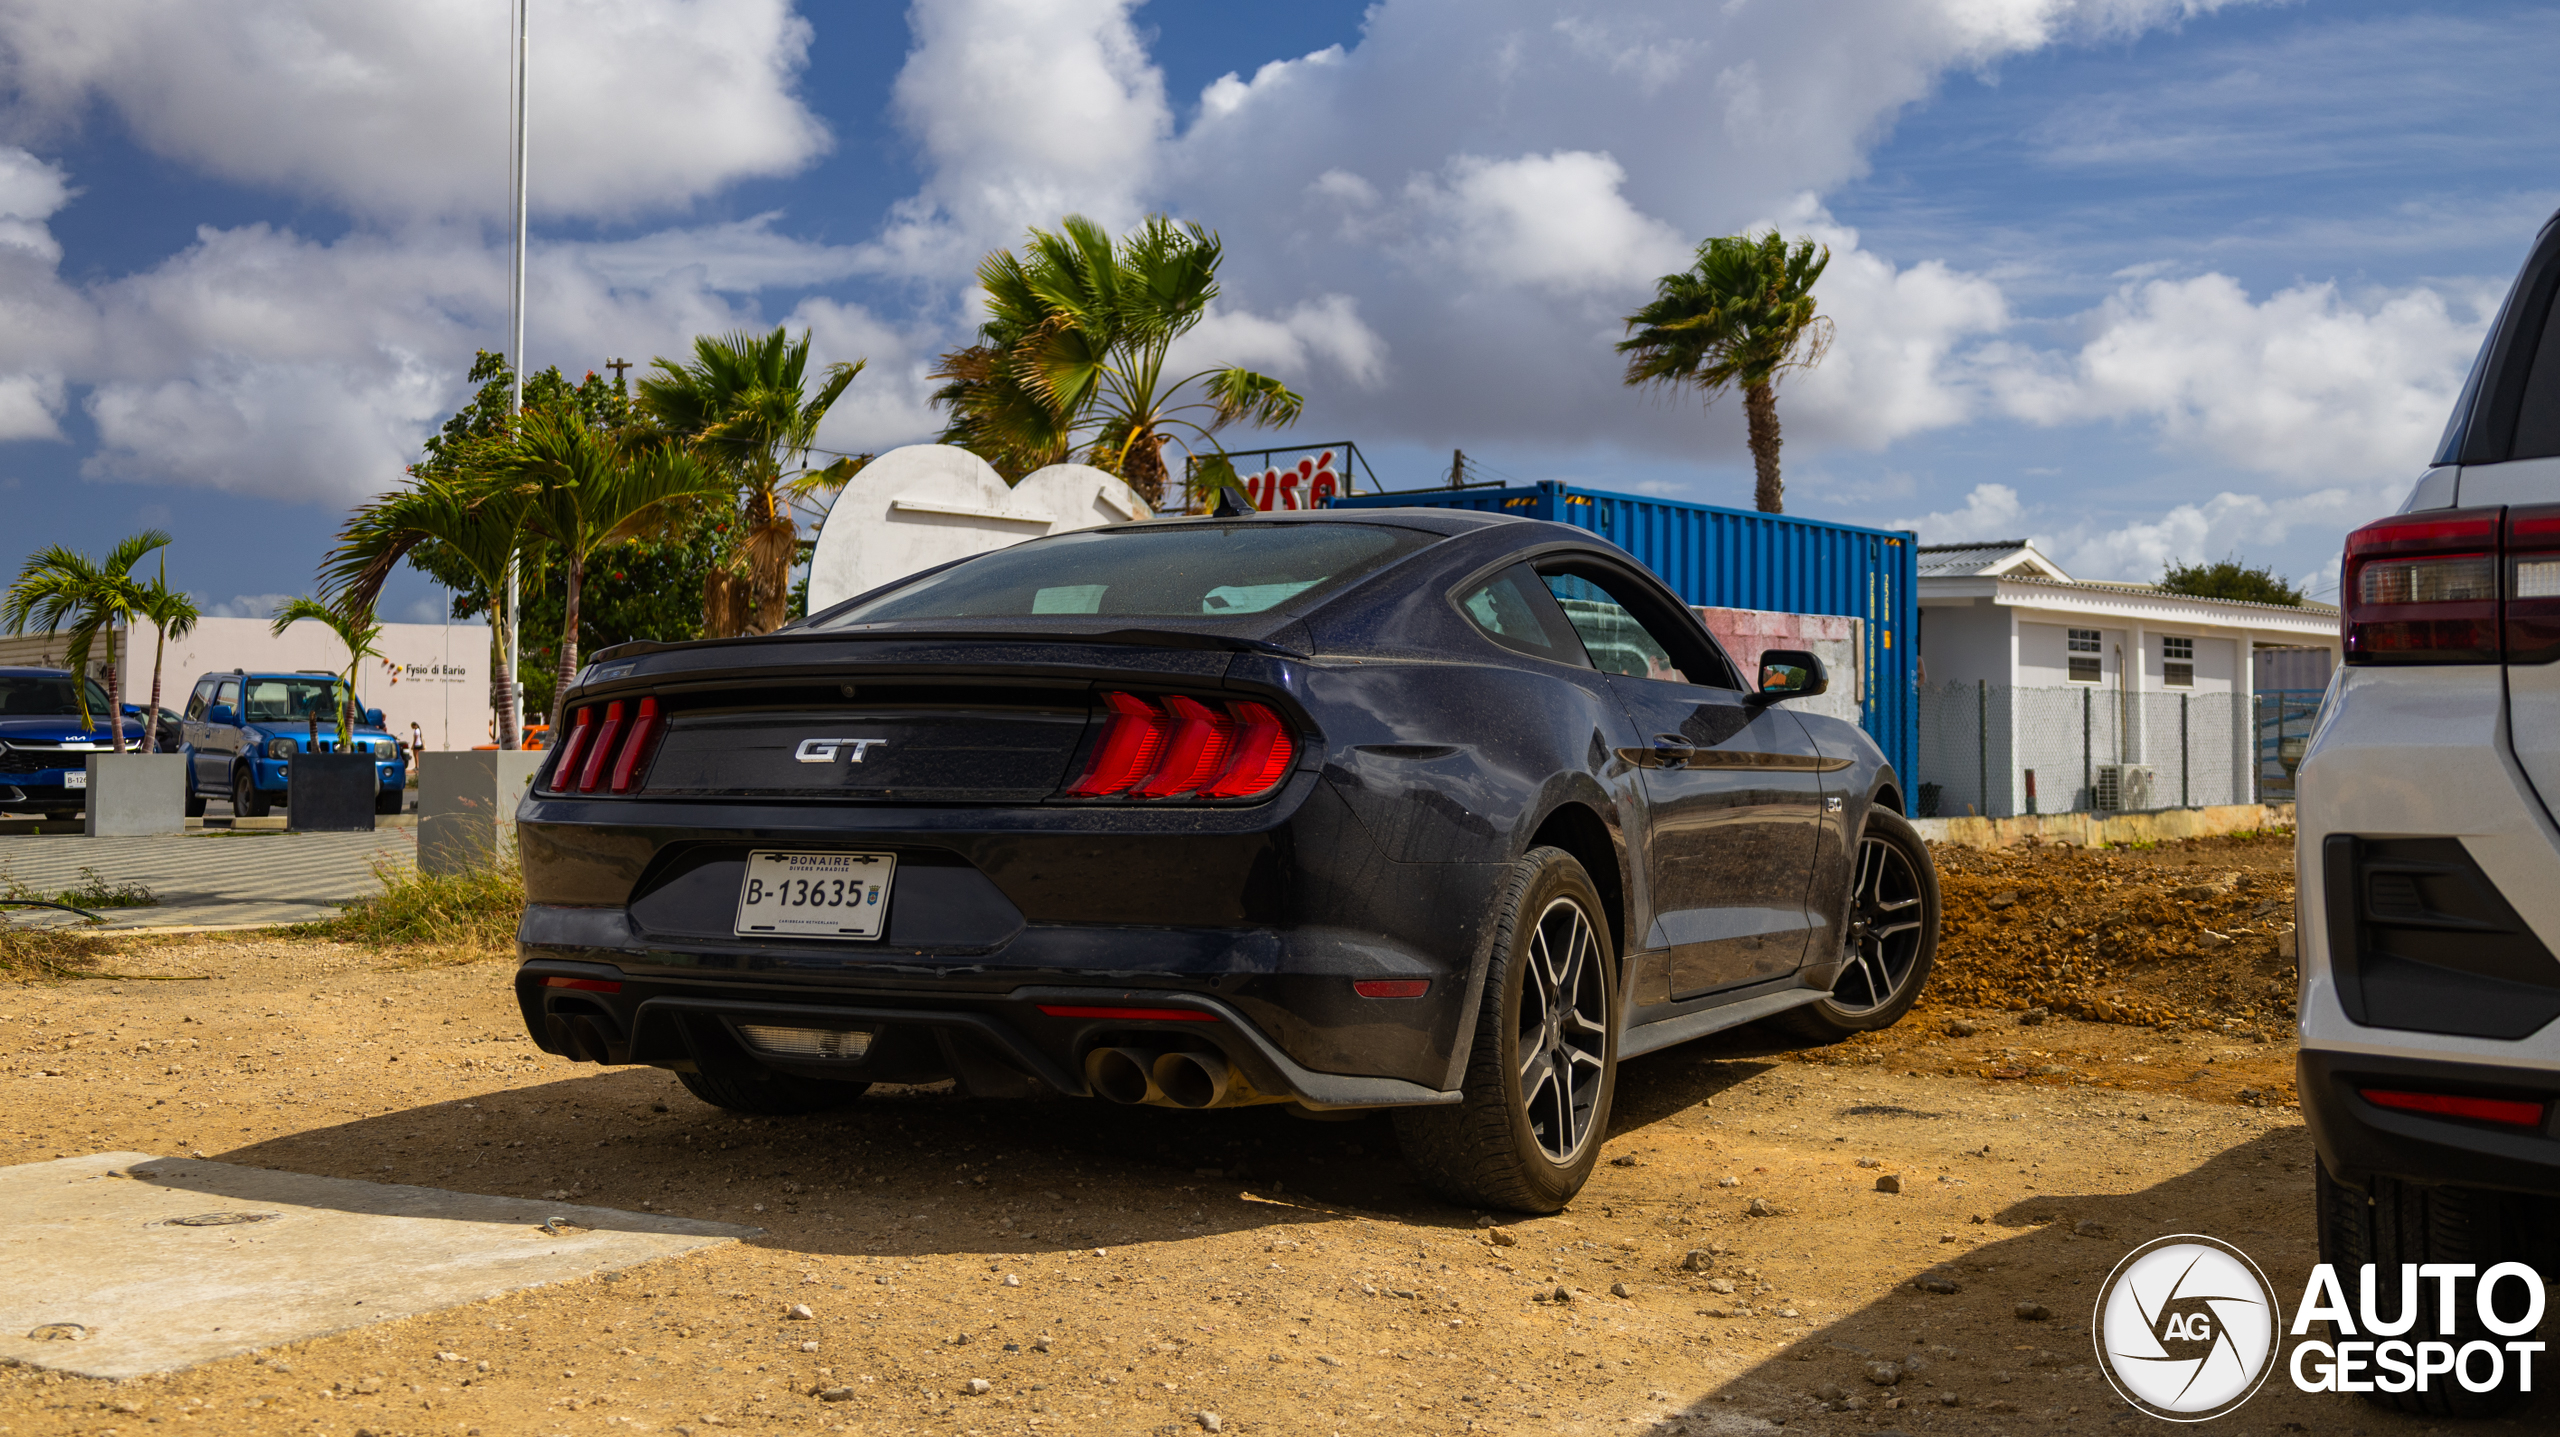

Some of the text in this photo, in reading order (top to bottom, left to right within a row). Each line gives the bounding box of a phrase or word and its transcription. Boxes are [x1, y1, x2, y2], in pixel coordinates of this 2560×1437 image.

[406, 664, 466, 677] Fysio di Bario
[795, 738, 889, 763] GT
[790, 856, 851, 866] BONAIRE
[746, 879, 864, 907] B-13635
